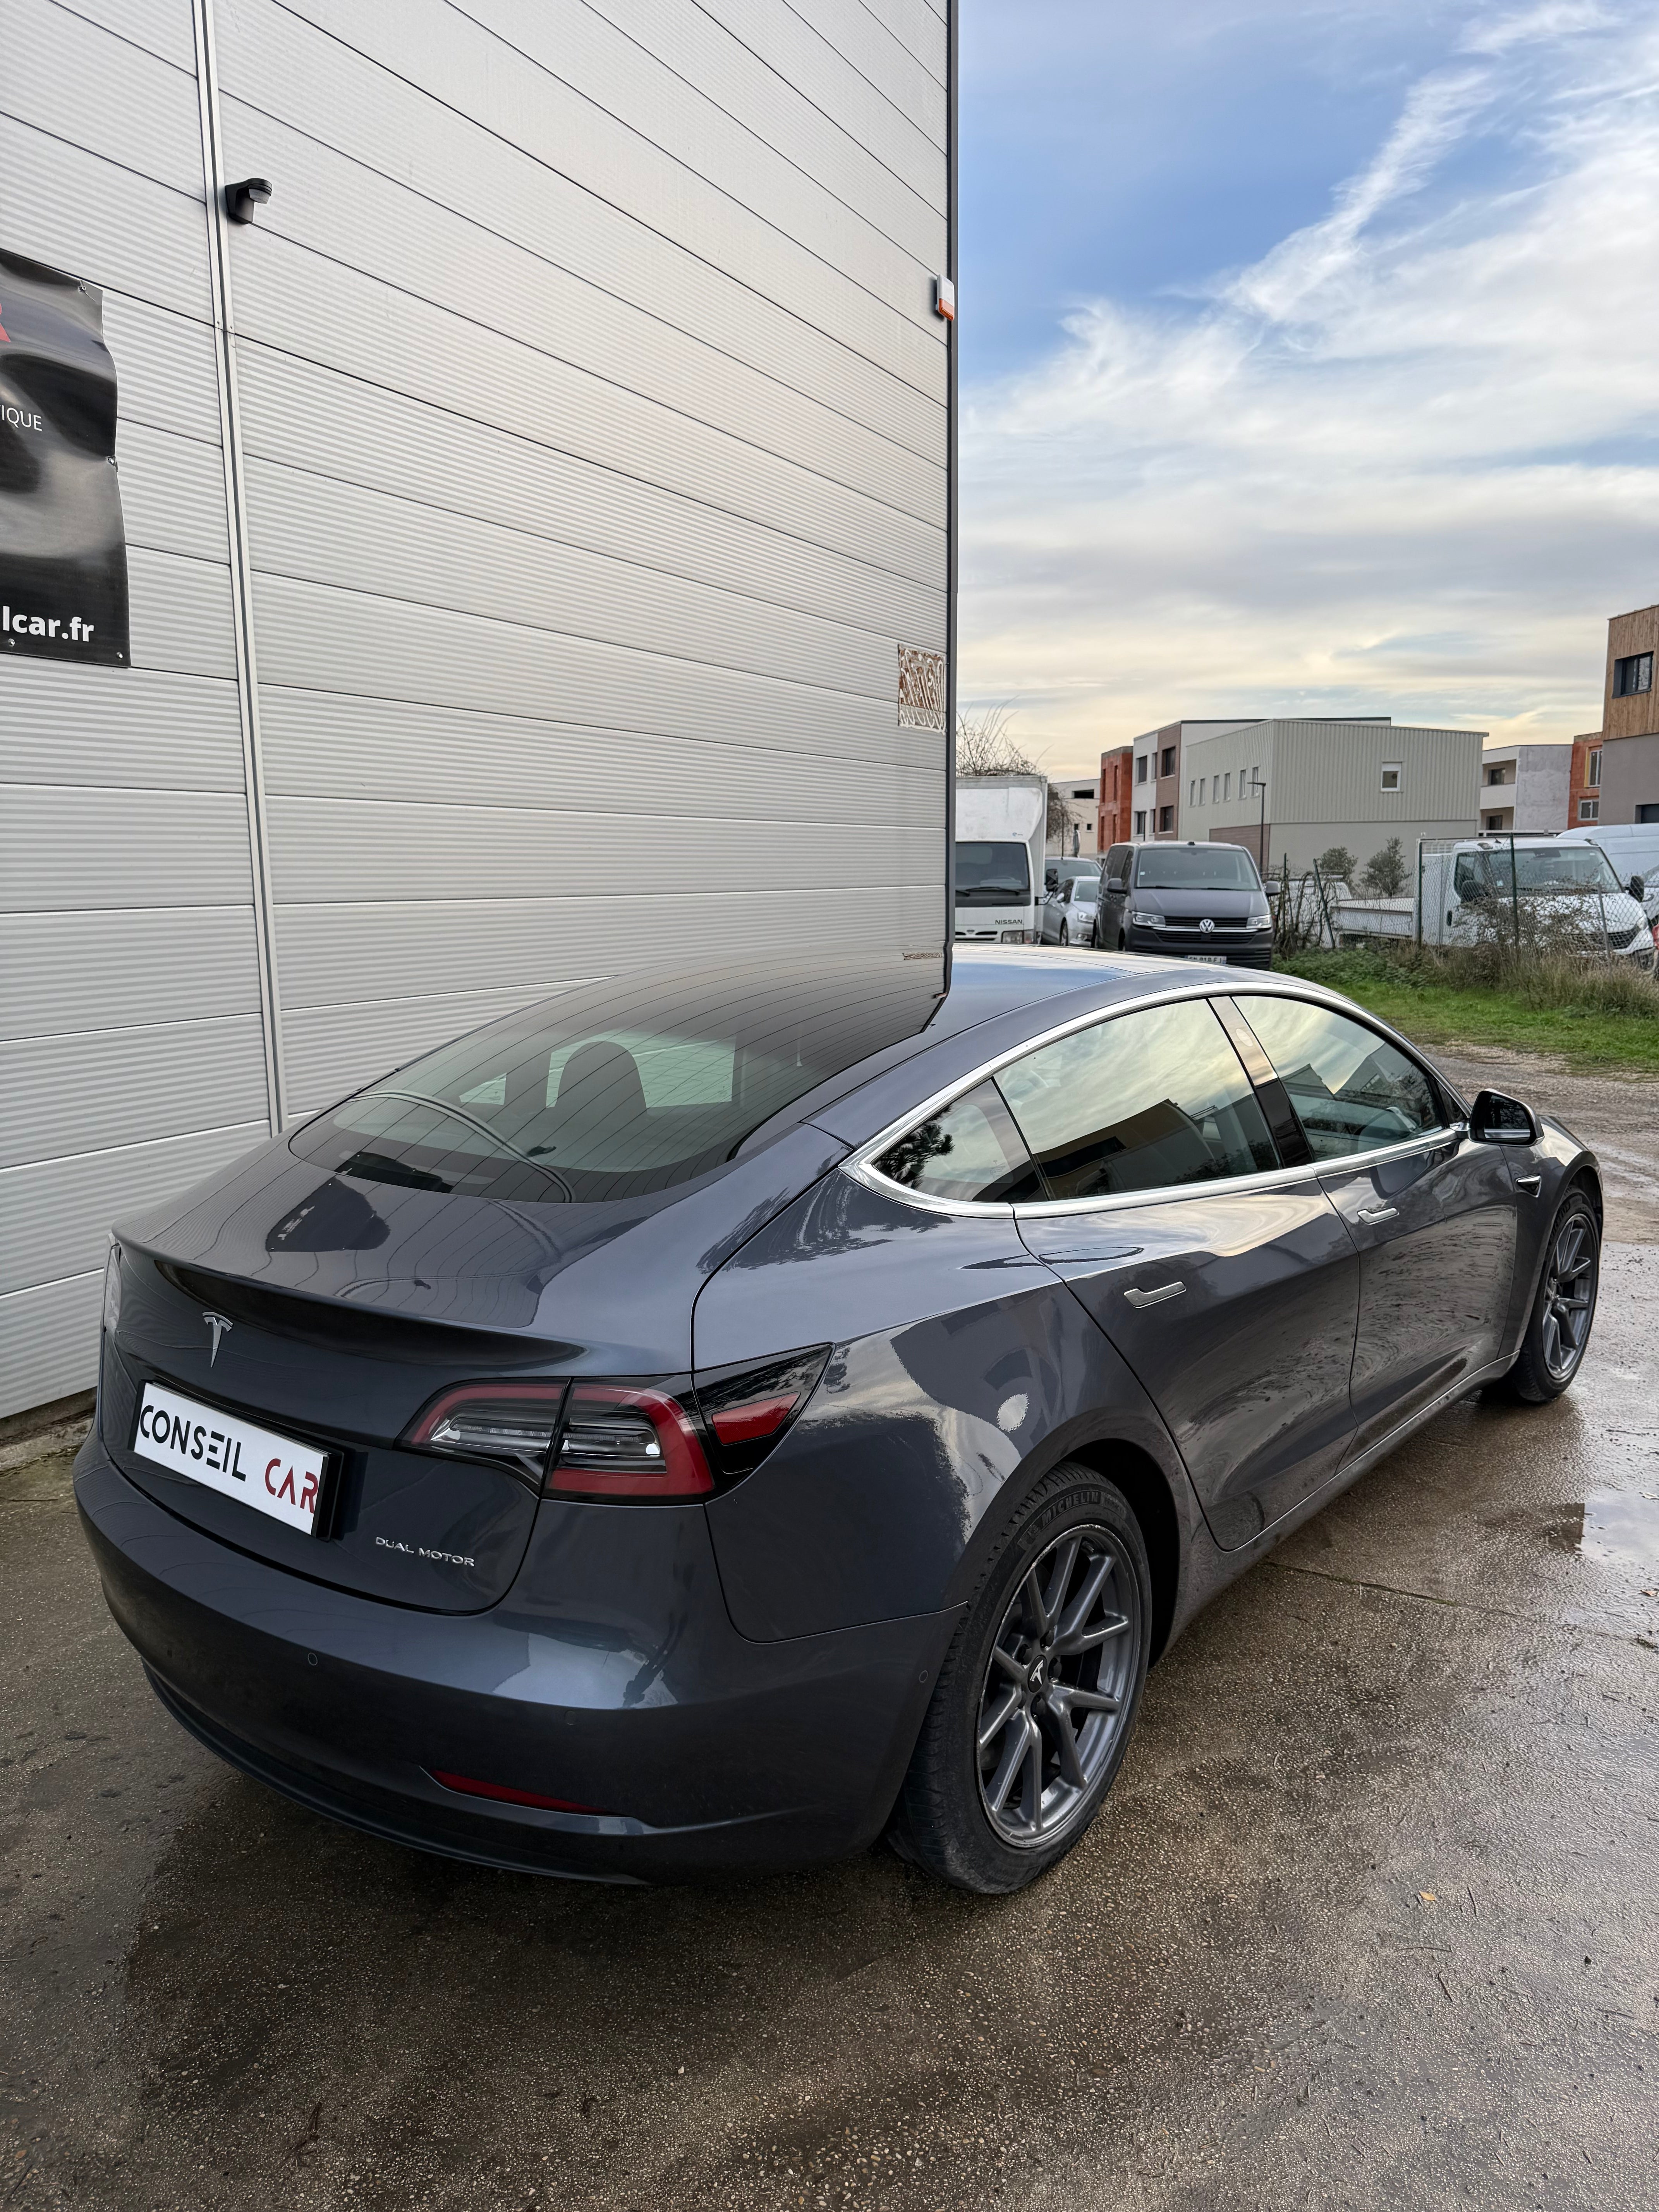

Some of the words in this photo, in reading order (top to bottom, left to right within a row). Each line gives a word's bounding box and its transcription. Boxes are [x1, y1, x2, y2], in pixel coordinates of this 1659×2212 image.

[0, 405, 42, 431] IQUE
[140, 1405, 247, 1482] CONSEIL
[265, 1458, 318, 1514] CAR
[1041, 1491, 1099, 1527] MICHELIN
[375, 1536, 414, 1554] DUAL
[418, 1547, 475, 1567] MOTOR
